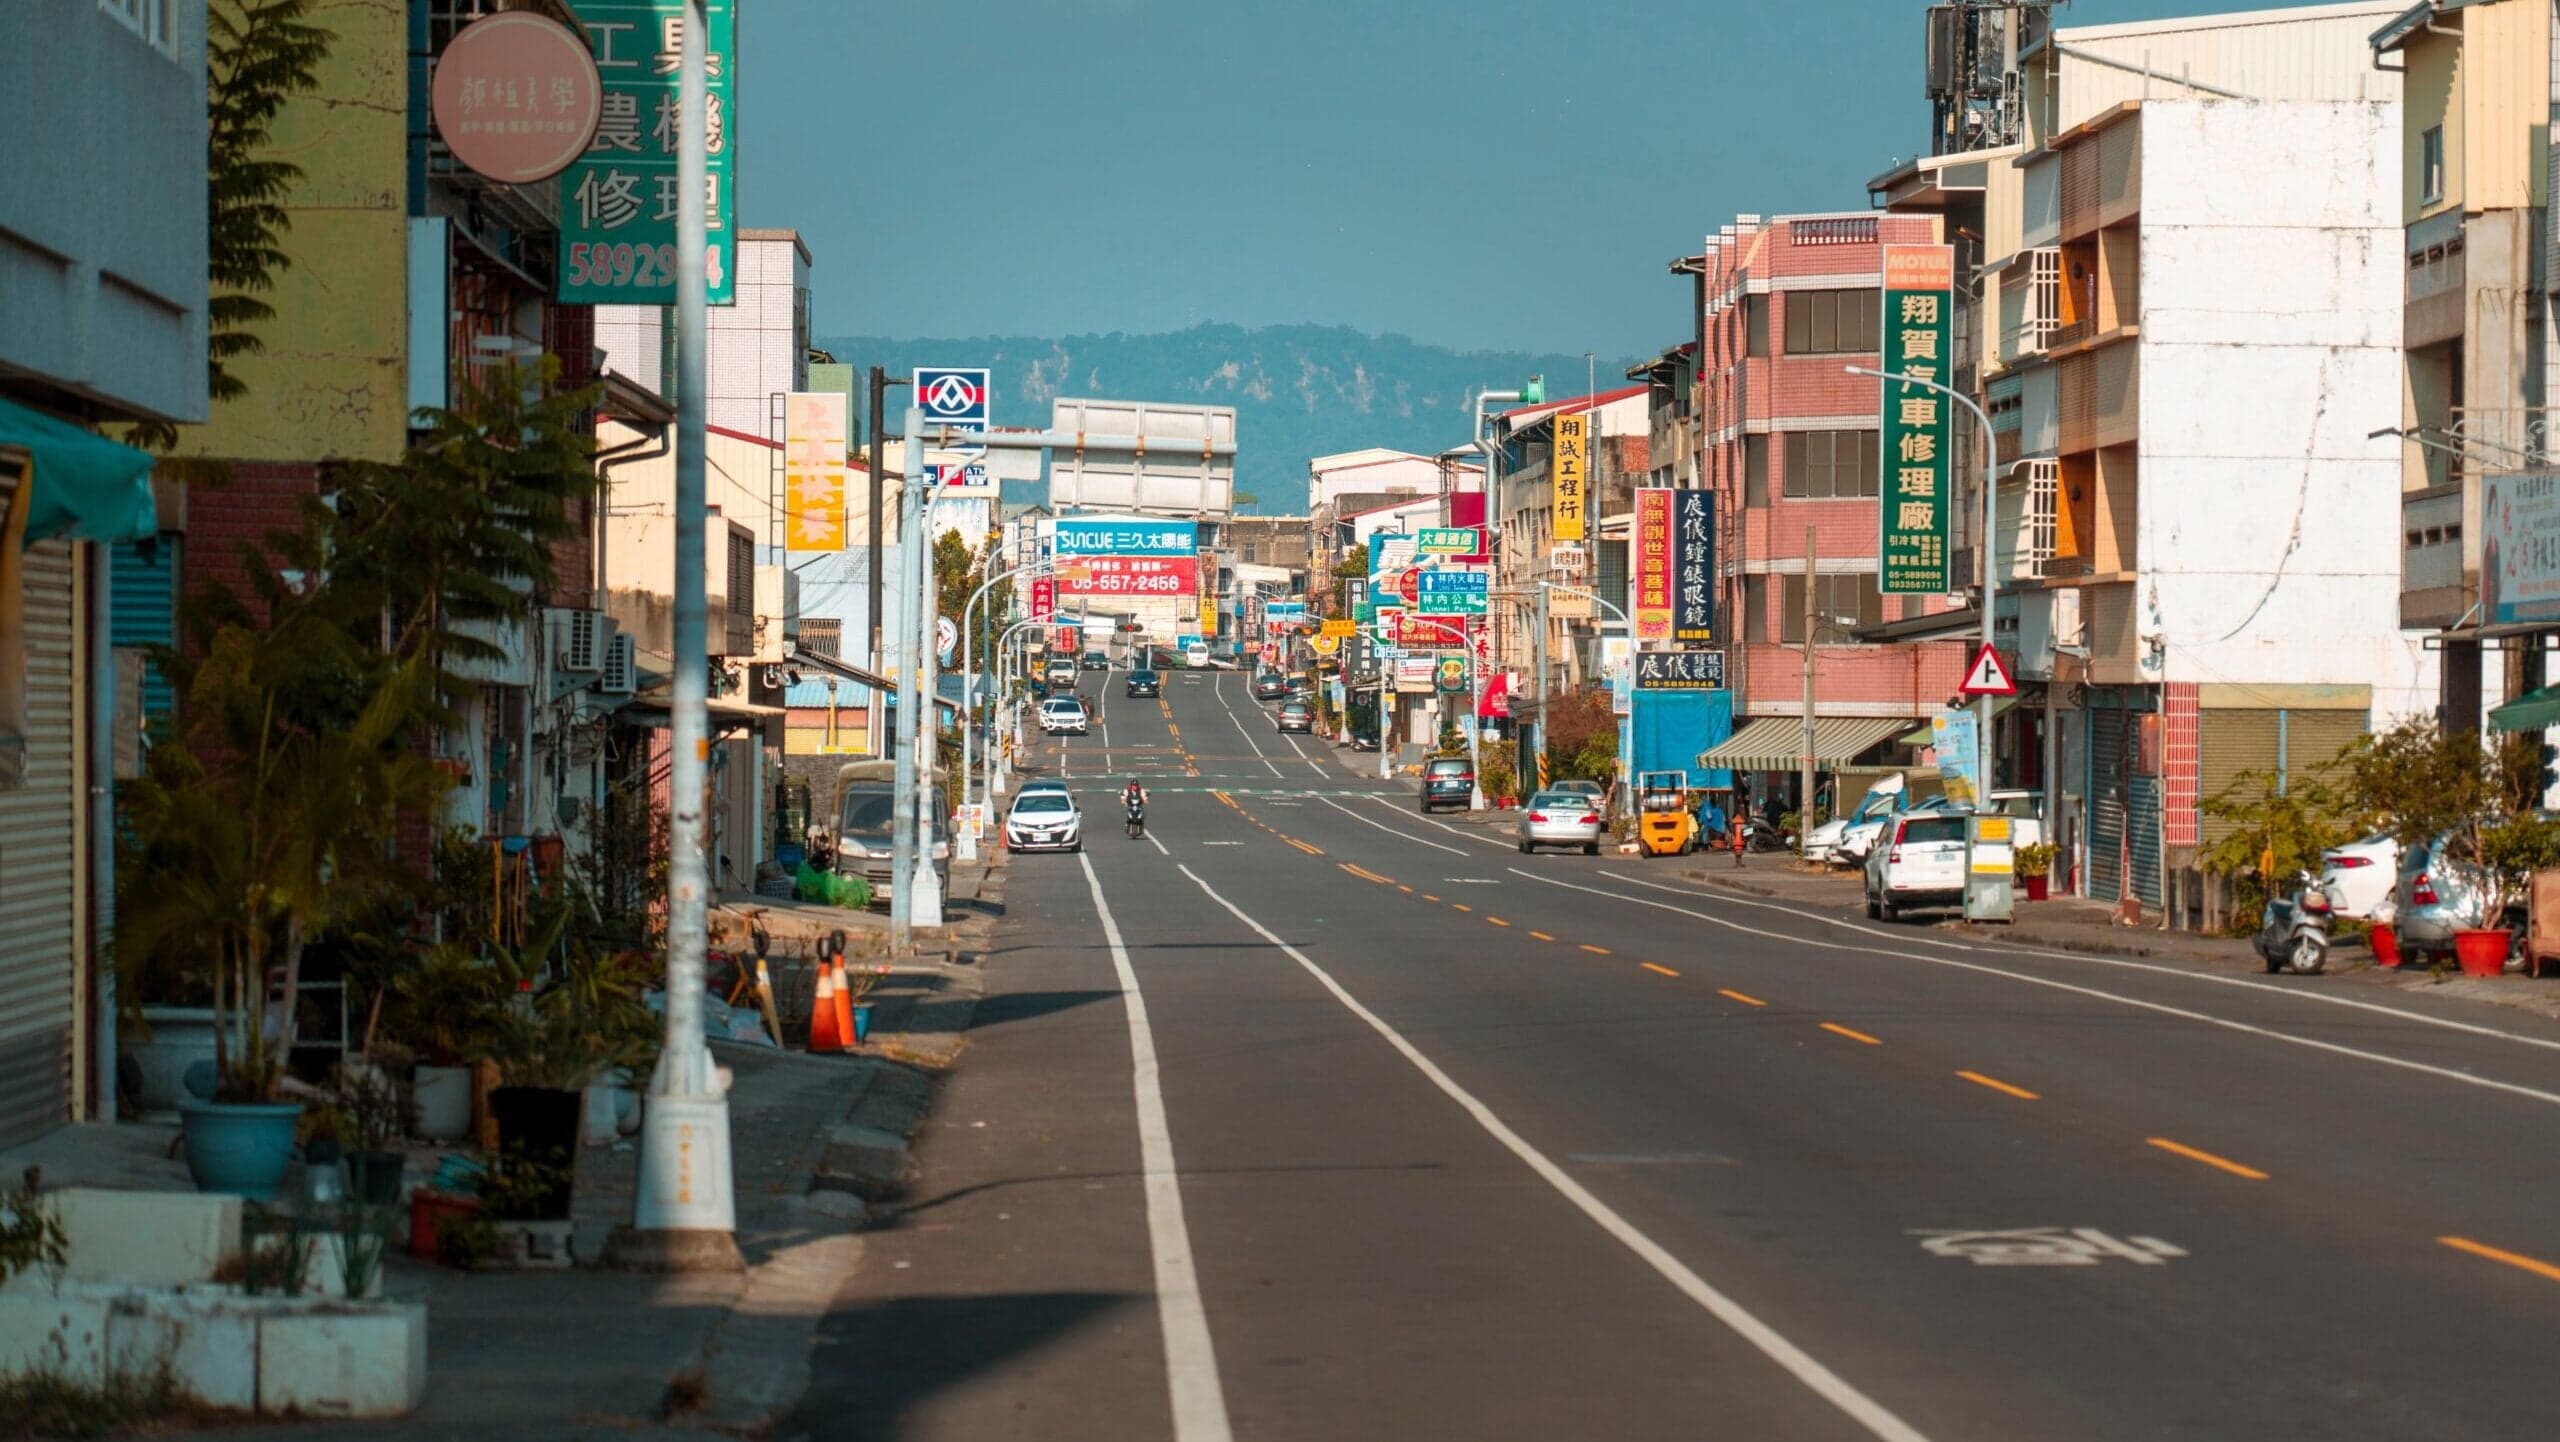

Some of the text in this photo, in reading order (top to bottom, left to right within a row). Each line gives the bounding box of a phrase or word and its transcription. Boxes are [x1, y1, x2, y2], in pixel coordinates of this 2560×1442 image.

[573, 168, 724, 232] 修理
[568, 243, 723, 289] 589294
[1888, 254, 1949, 269] MOTUL
[1897, 295, 1939, 532] 翔賀汽車修理廠
[1558, 419, 1580, 520] 翔誠工程行
[1117, 532, 1192, 550] 三久太陽能
[1643, 493, 1665, 606] 南無觀世音菩薩
